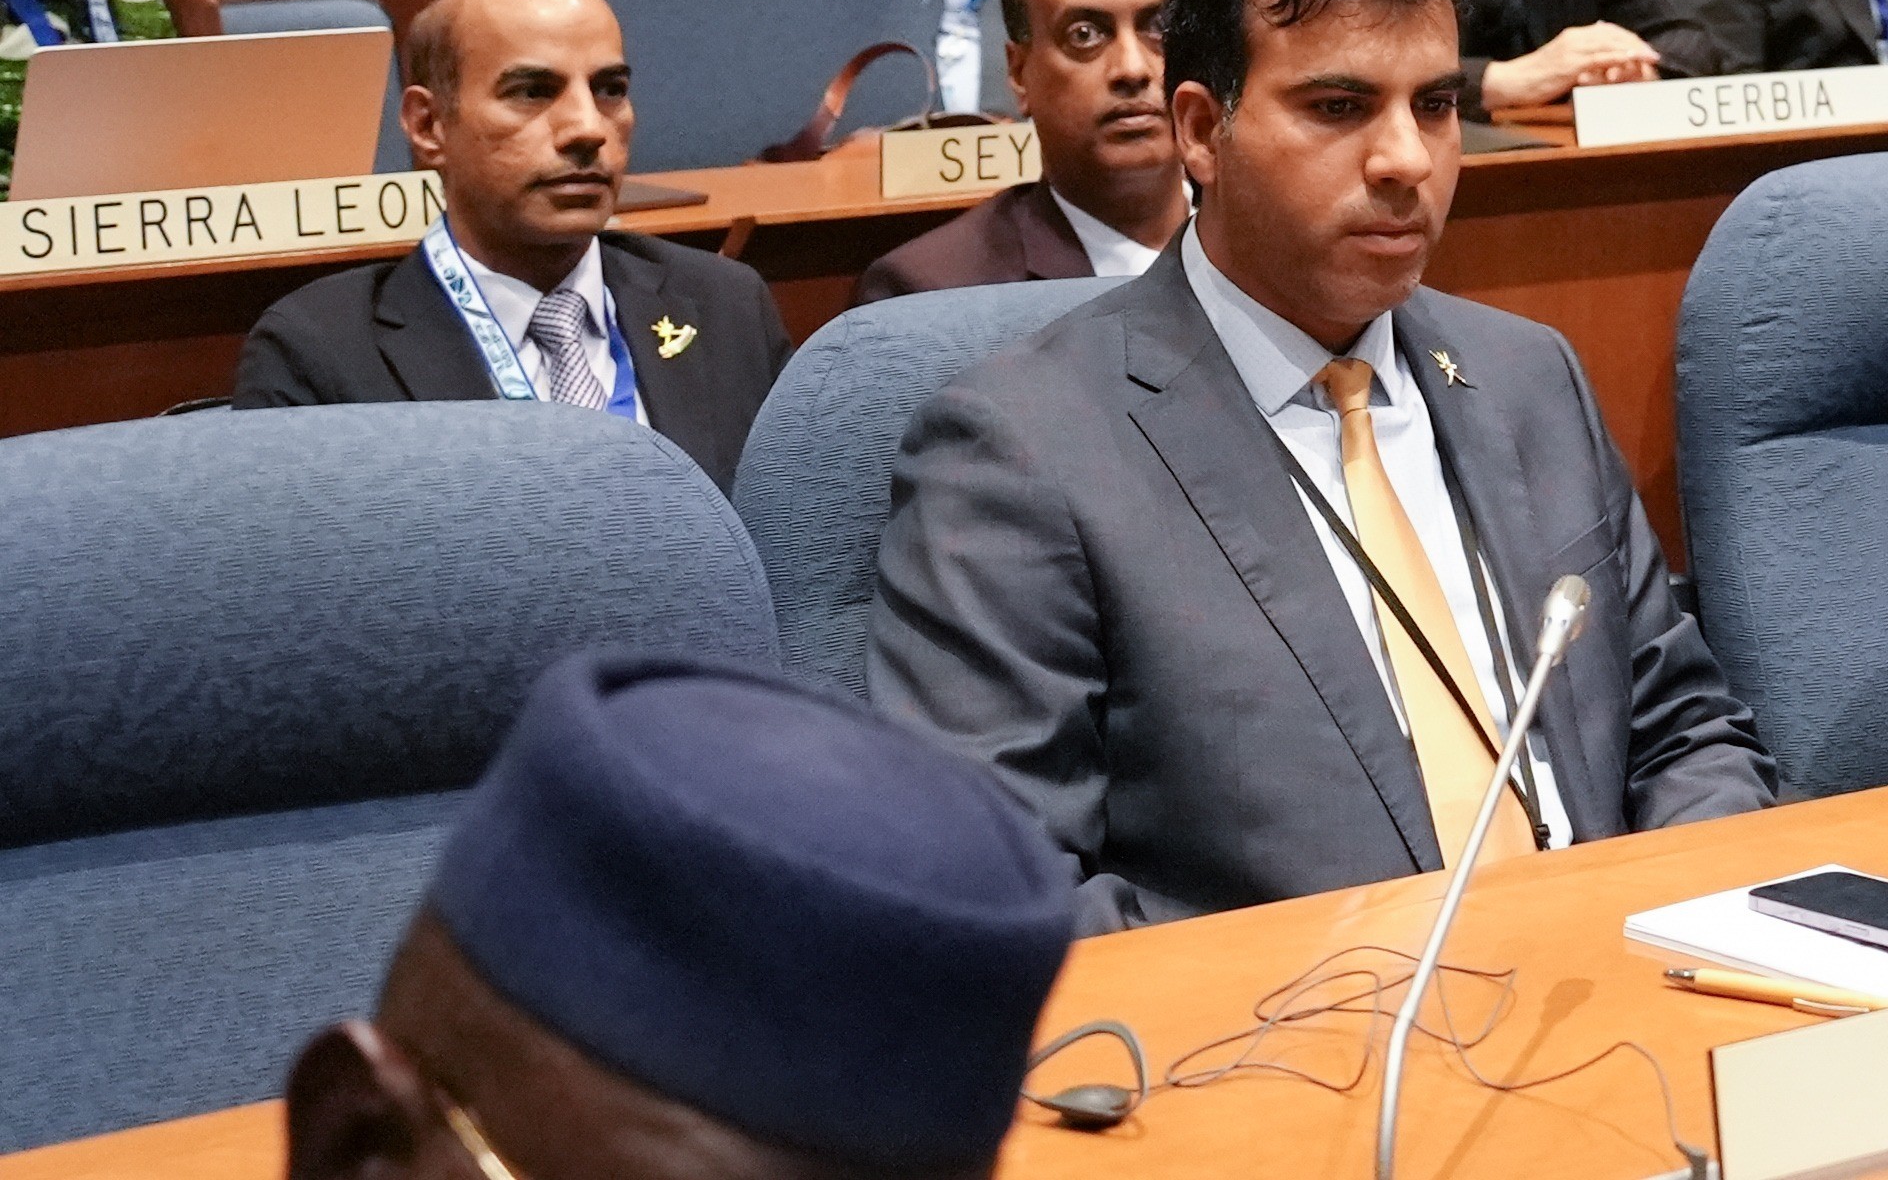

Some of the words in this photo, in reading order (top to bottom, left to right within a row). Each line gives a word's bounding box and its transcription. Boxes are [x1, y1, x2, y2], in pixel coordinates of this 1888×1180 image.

[1687, 79, 1835, 128] SERBIA
[939, 131, 1032, 183] SEY
[21, 191, 264, 259] SIERRA
